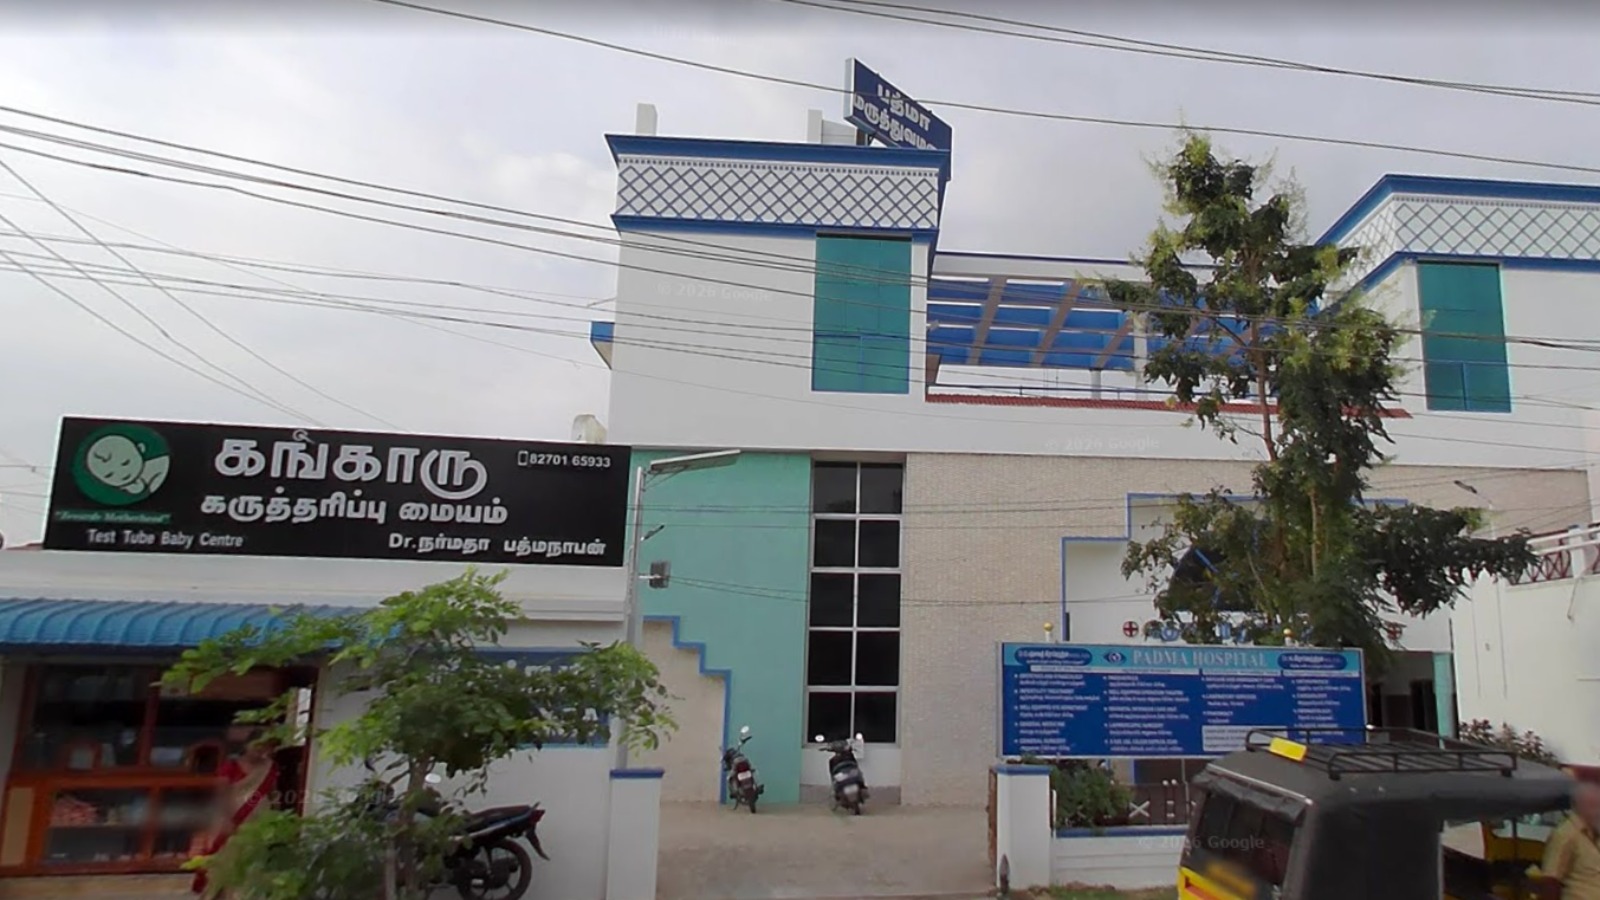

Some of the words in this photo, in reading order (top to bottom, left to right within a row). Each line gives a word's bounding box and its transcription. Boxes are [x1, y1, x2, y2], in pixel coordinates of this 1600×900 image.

[877, 83, 931, 131] பத்மா
[214, 428, 488, 500] கங்காரு
[529, 452, 568, 465] 82701
[571, 454, 612, 468] 65933
[200, 486, 387, 524] கருத்தரிப்பு
[399, 497, 508, 524] மையம்
[87, 528, 116, 544] Test
[123, 530, 156, 545] Tube
[161, 531, 194, 550] Baby
[199, 532, 245, 548] Centre
[503, 536, 607, 558] பத்மநாபன்
[1133, 648, 1189, 666] PADMA
[1192, 651, 1268, 668] HOSPITAL
